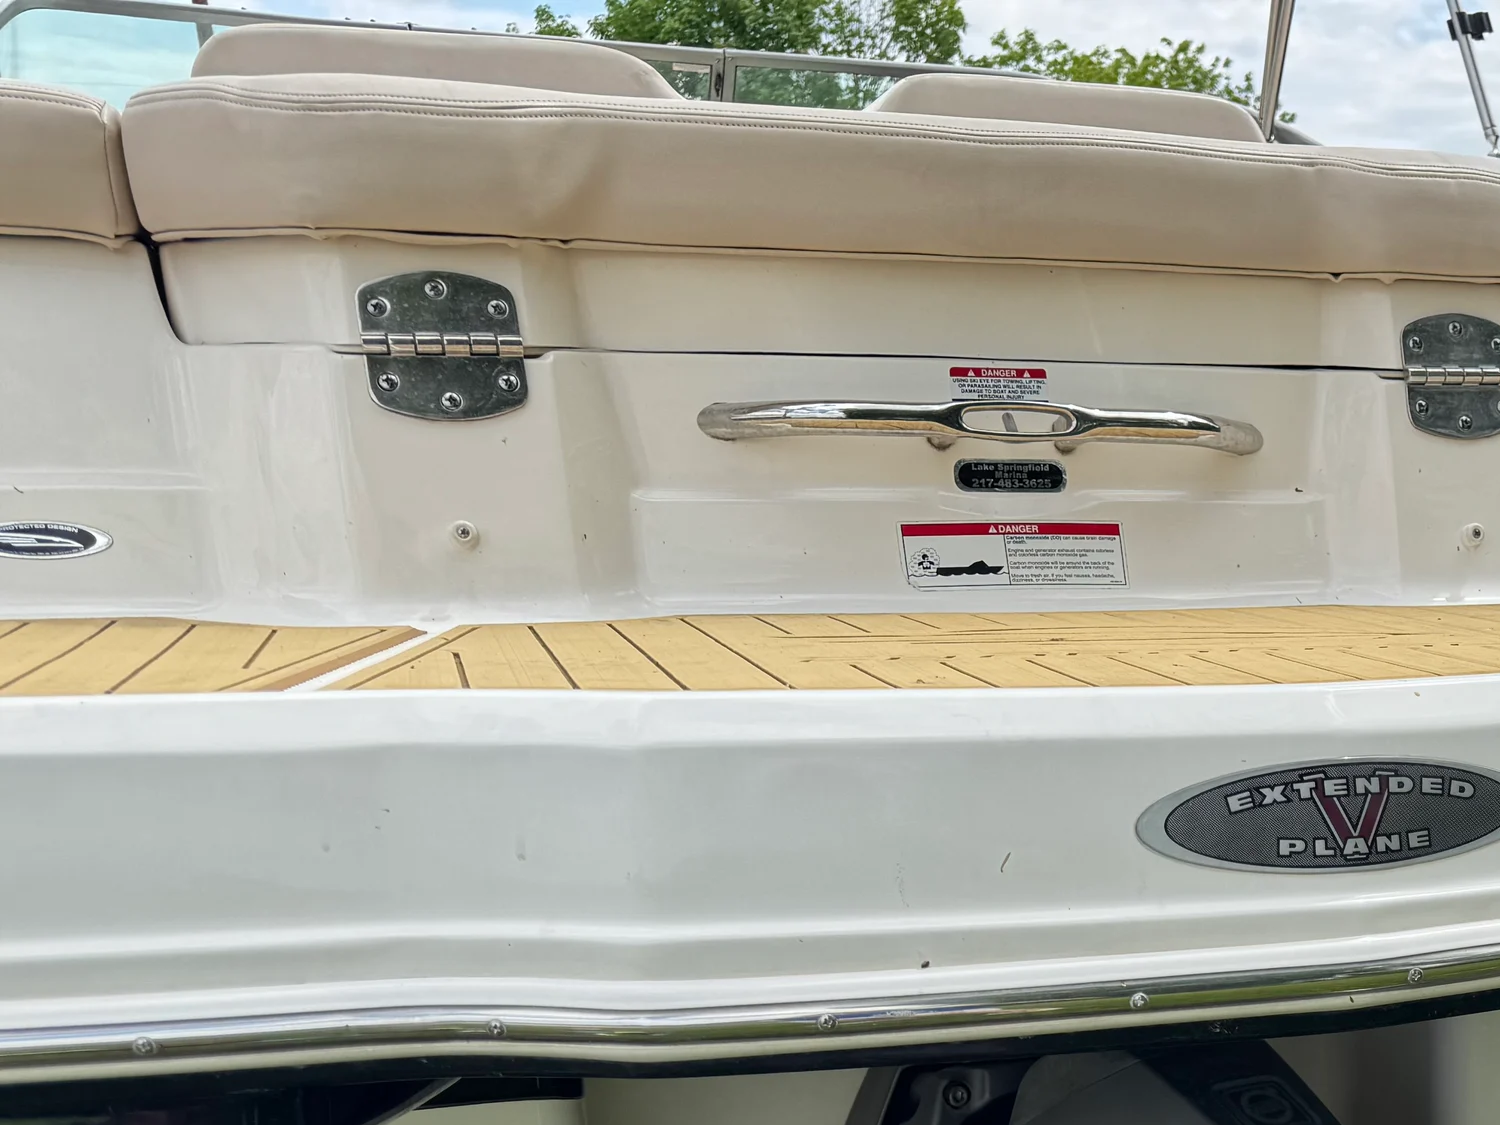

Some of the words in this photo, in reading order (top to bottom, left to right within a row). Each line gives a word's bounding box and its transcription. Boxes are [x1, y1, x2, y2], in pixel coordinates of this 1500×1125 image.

[998, 464, 1049, 472] Springfield
[972, 479, 1052, 488] 217-483-3625
[47, 523, 79, 533] DESIGN
[998, 525, 1039, 533] DANGER
[1226, 775, 1476, 812] EXTENDED
[1278, 830, 1432, 857] PLANE
